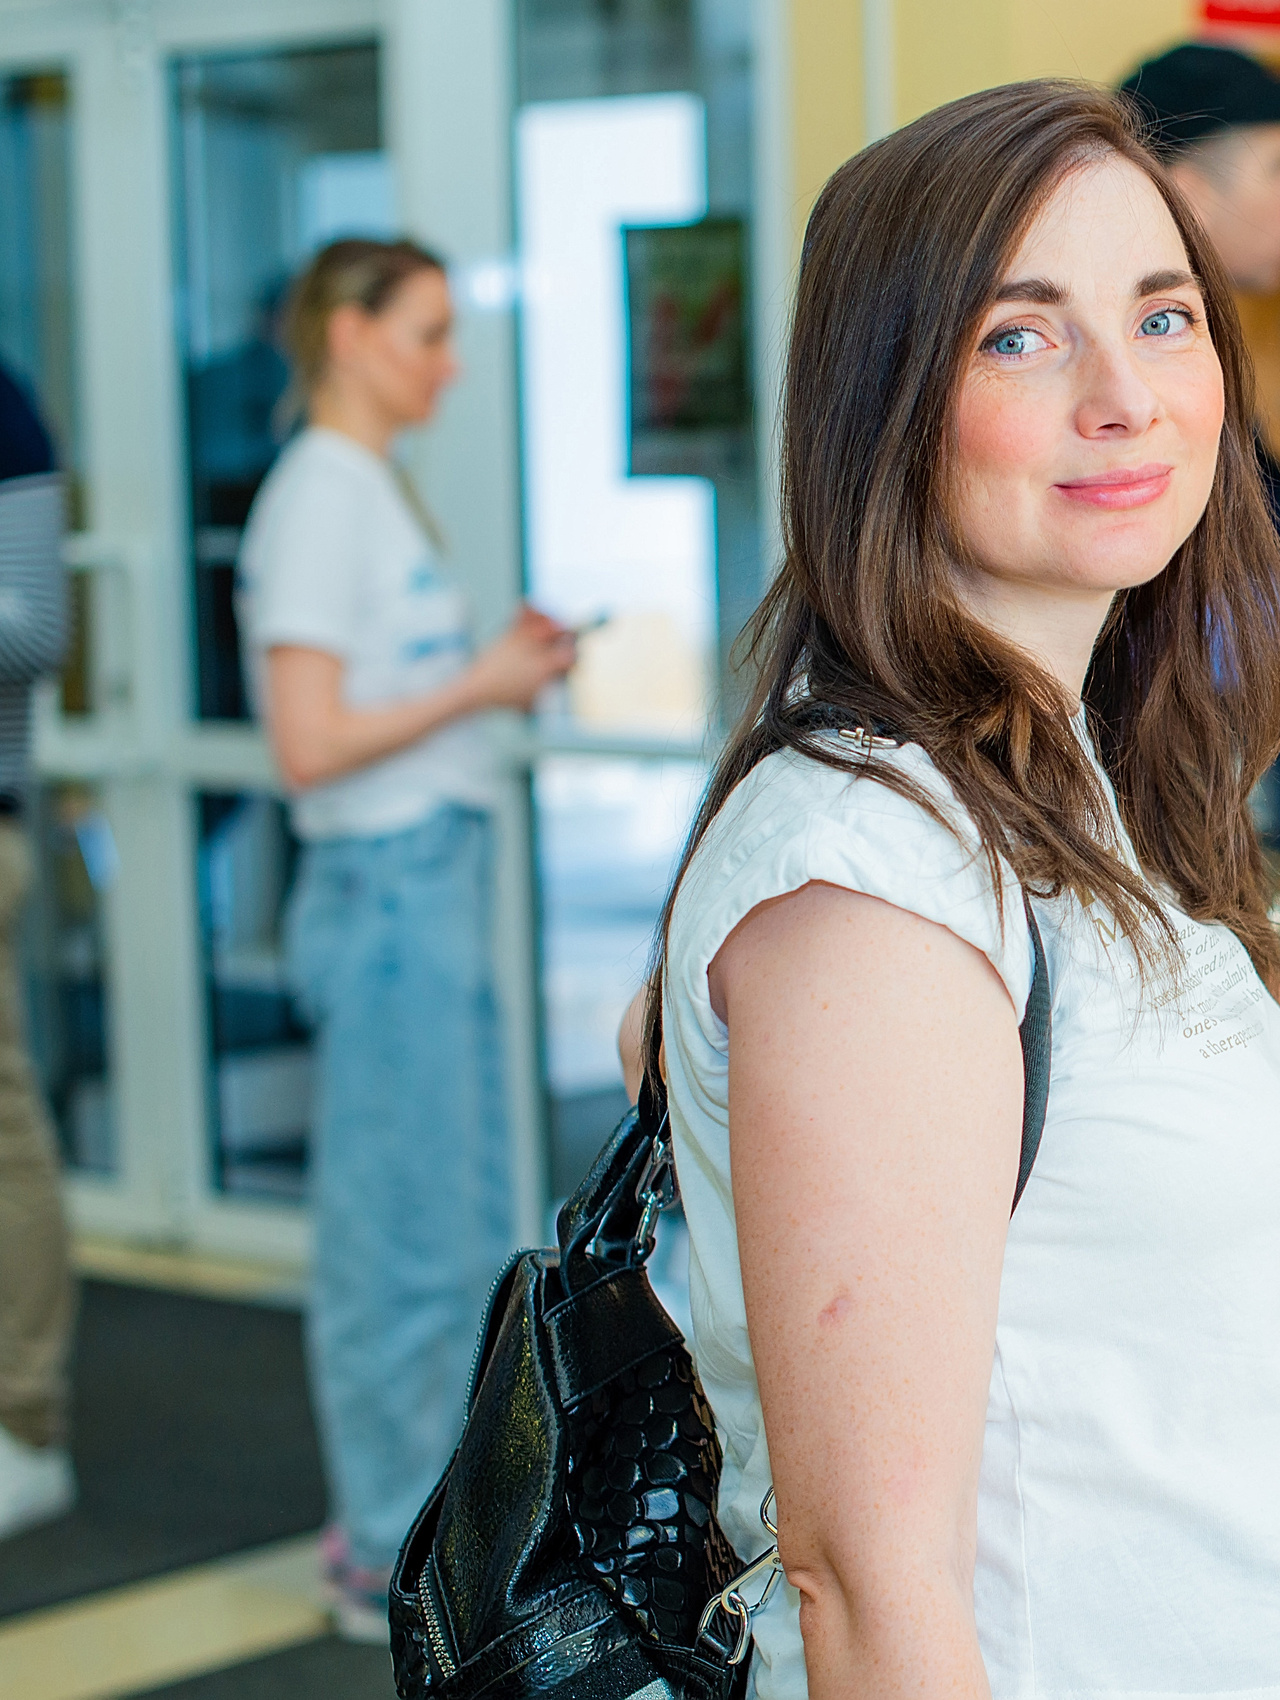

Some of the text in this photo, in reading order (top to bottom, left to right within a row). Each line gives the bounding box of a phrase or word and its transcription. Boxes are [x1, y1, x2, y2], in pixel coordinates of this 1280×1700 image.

[1194, 934, 1208, 955] of
[1221, 963, 1249, 991] calmly
[1183, 1017, 1218, 1039] ones
[1199, 1048, 1210, 1059] a
